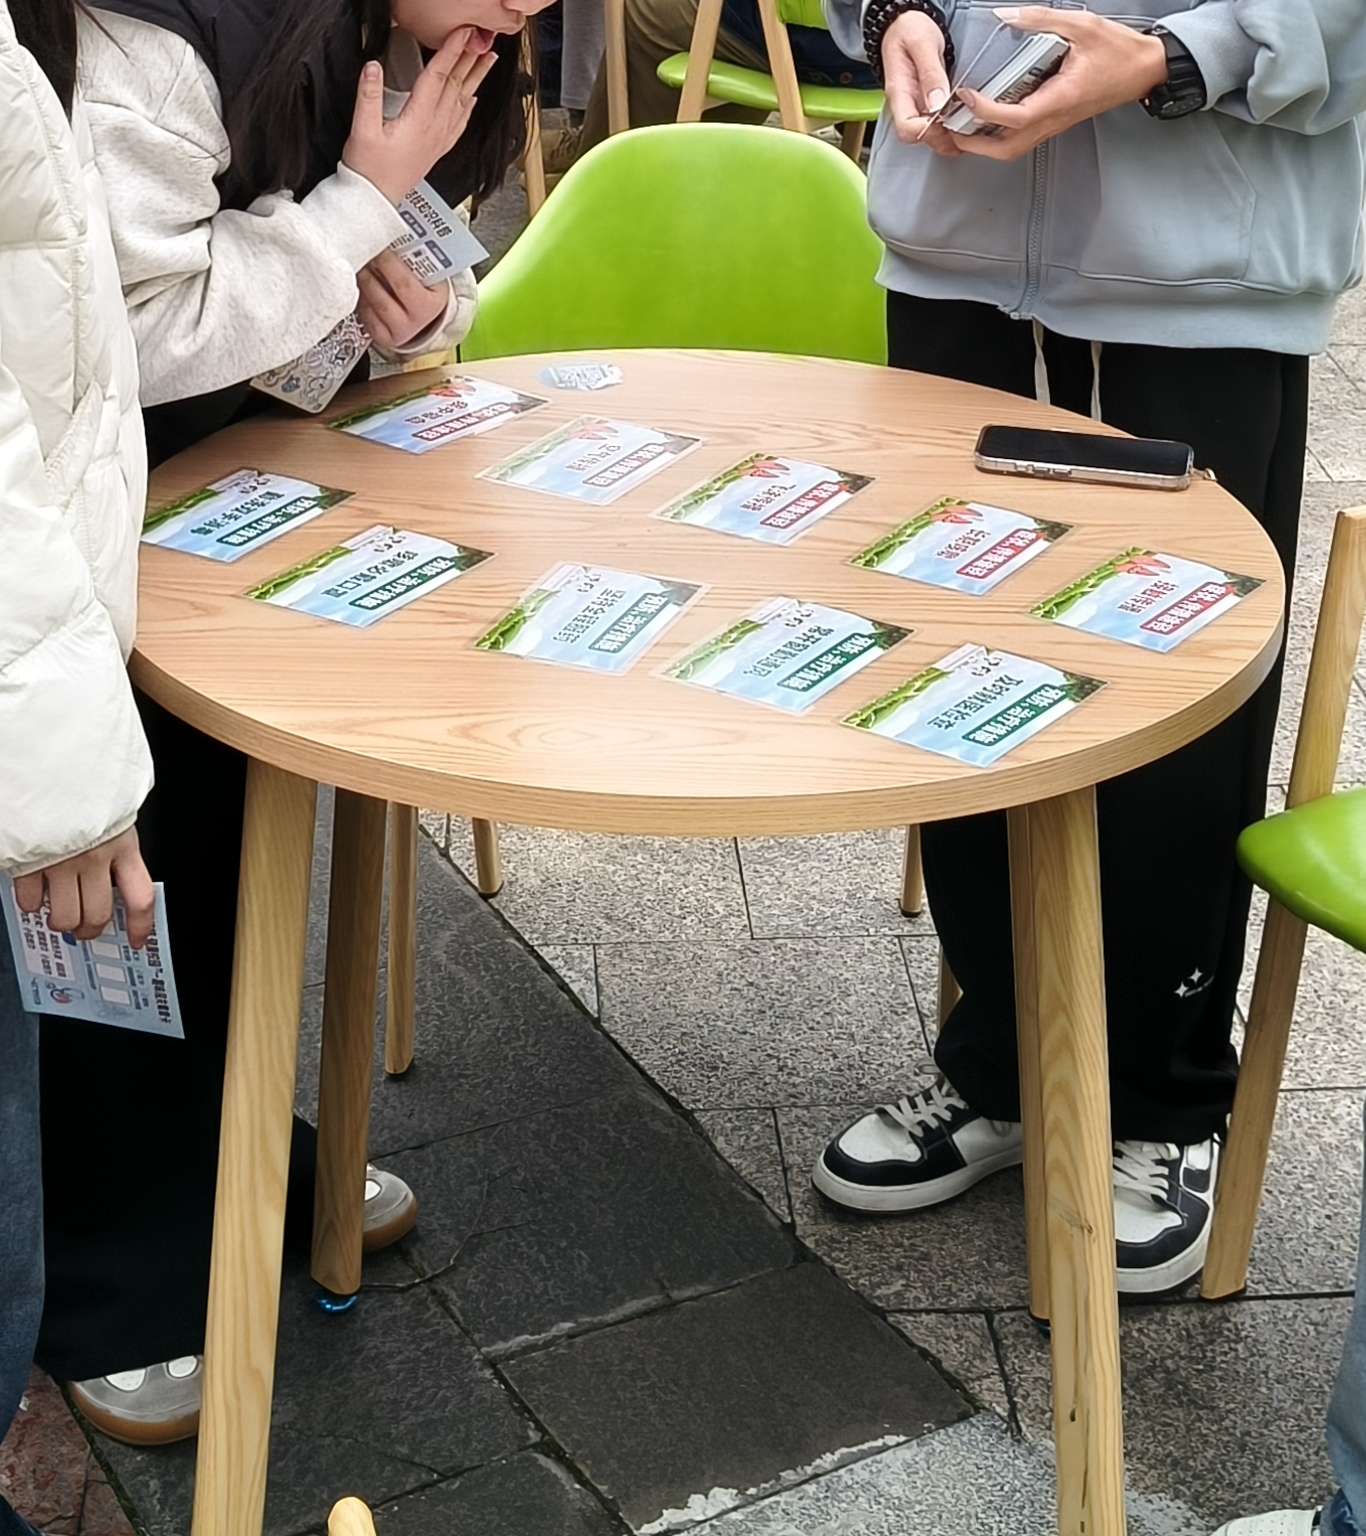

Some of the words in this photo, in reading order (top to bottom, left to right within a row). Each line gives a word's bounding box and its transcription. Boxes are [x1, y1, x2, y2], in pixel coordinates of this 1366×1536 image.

[562, 443, 623, 472] 空气传播
[737, 483, 797, 512] 飞沫传播
[1116, 580, 1179, 613] 接触传播
[924, 674, 1025, 730] 及时就医检查
